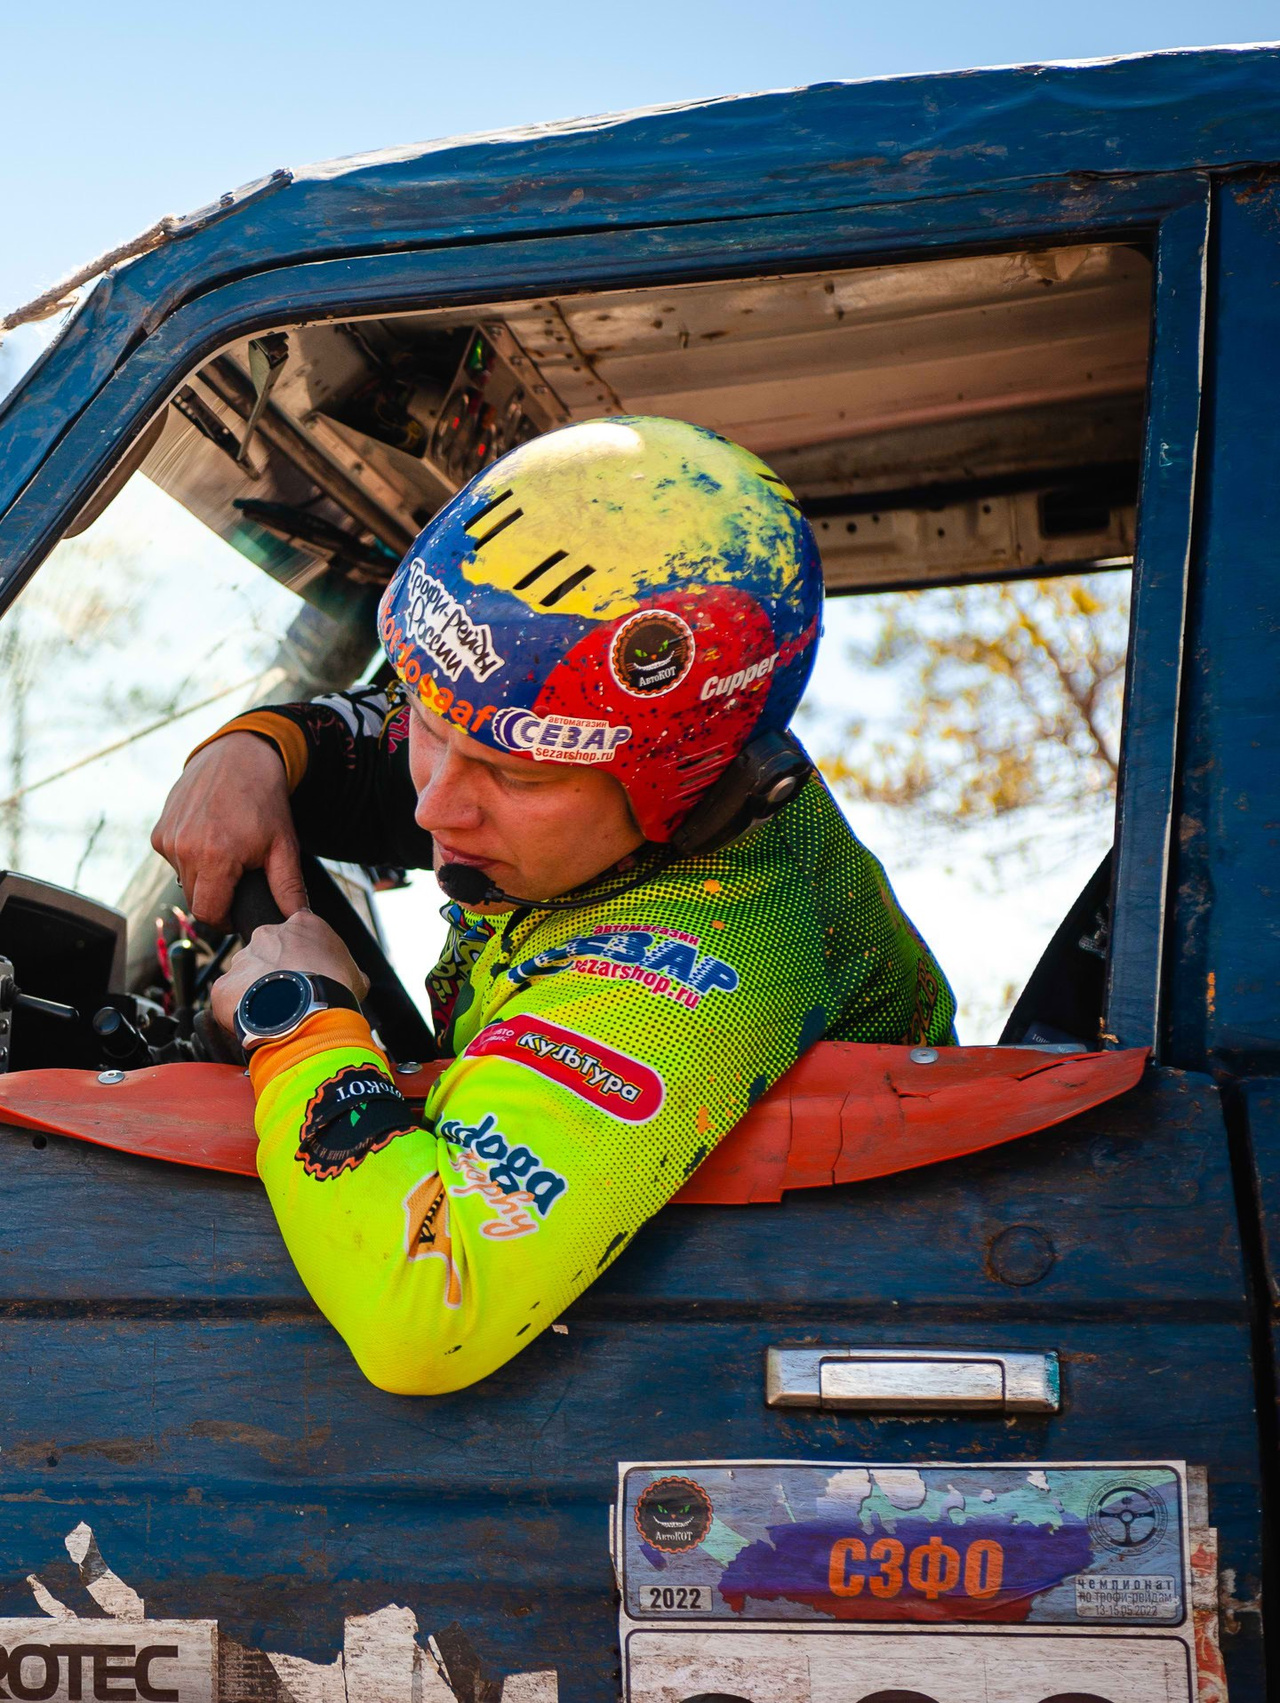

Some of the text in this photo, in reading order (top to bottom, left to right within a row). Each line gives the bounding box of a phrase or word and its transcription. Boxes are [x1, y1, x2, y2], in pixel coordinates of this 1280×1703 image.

[407, 596, 464, 677] России
[700, 651, 780, 700] Cupper
[520, 719, 631, 750] СЕЗАР
[548, 715, 608, 728] автомагазин
[535, 747, 613, 761] sezarshop.ru
[593, 924, 700, 946] автомагазин
[570, 958, 702, 1010] sezarshop.ru
[436, 1115, 566, 1216] adoga
[828, 1536, 1005, 1600] СЗФО
[650, 1587, 702, 1609] 2022
